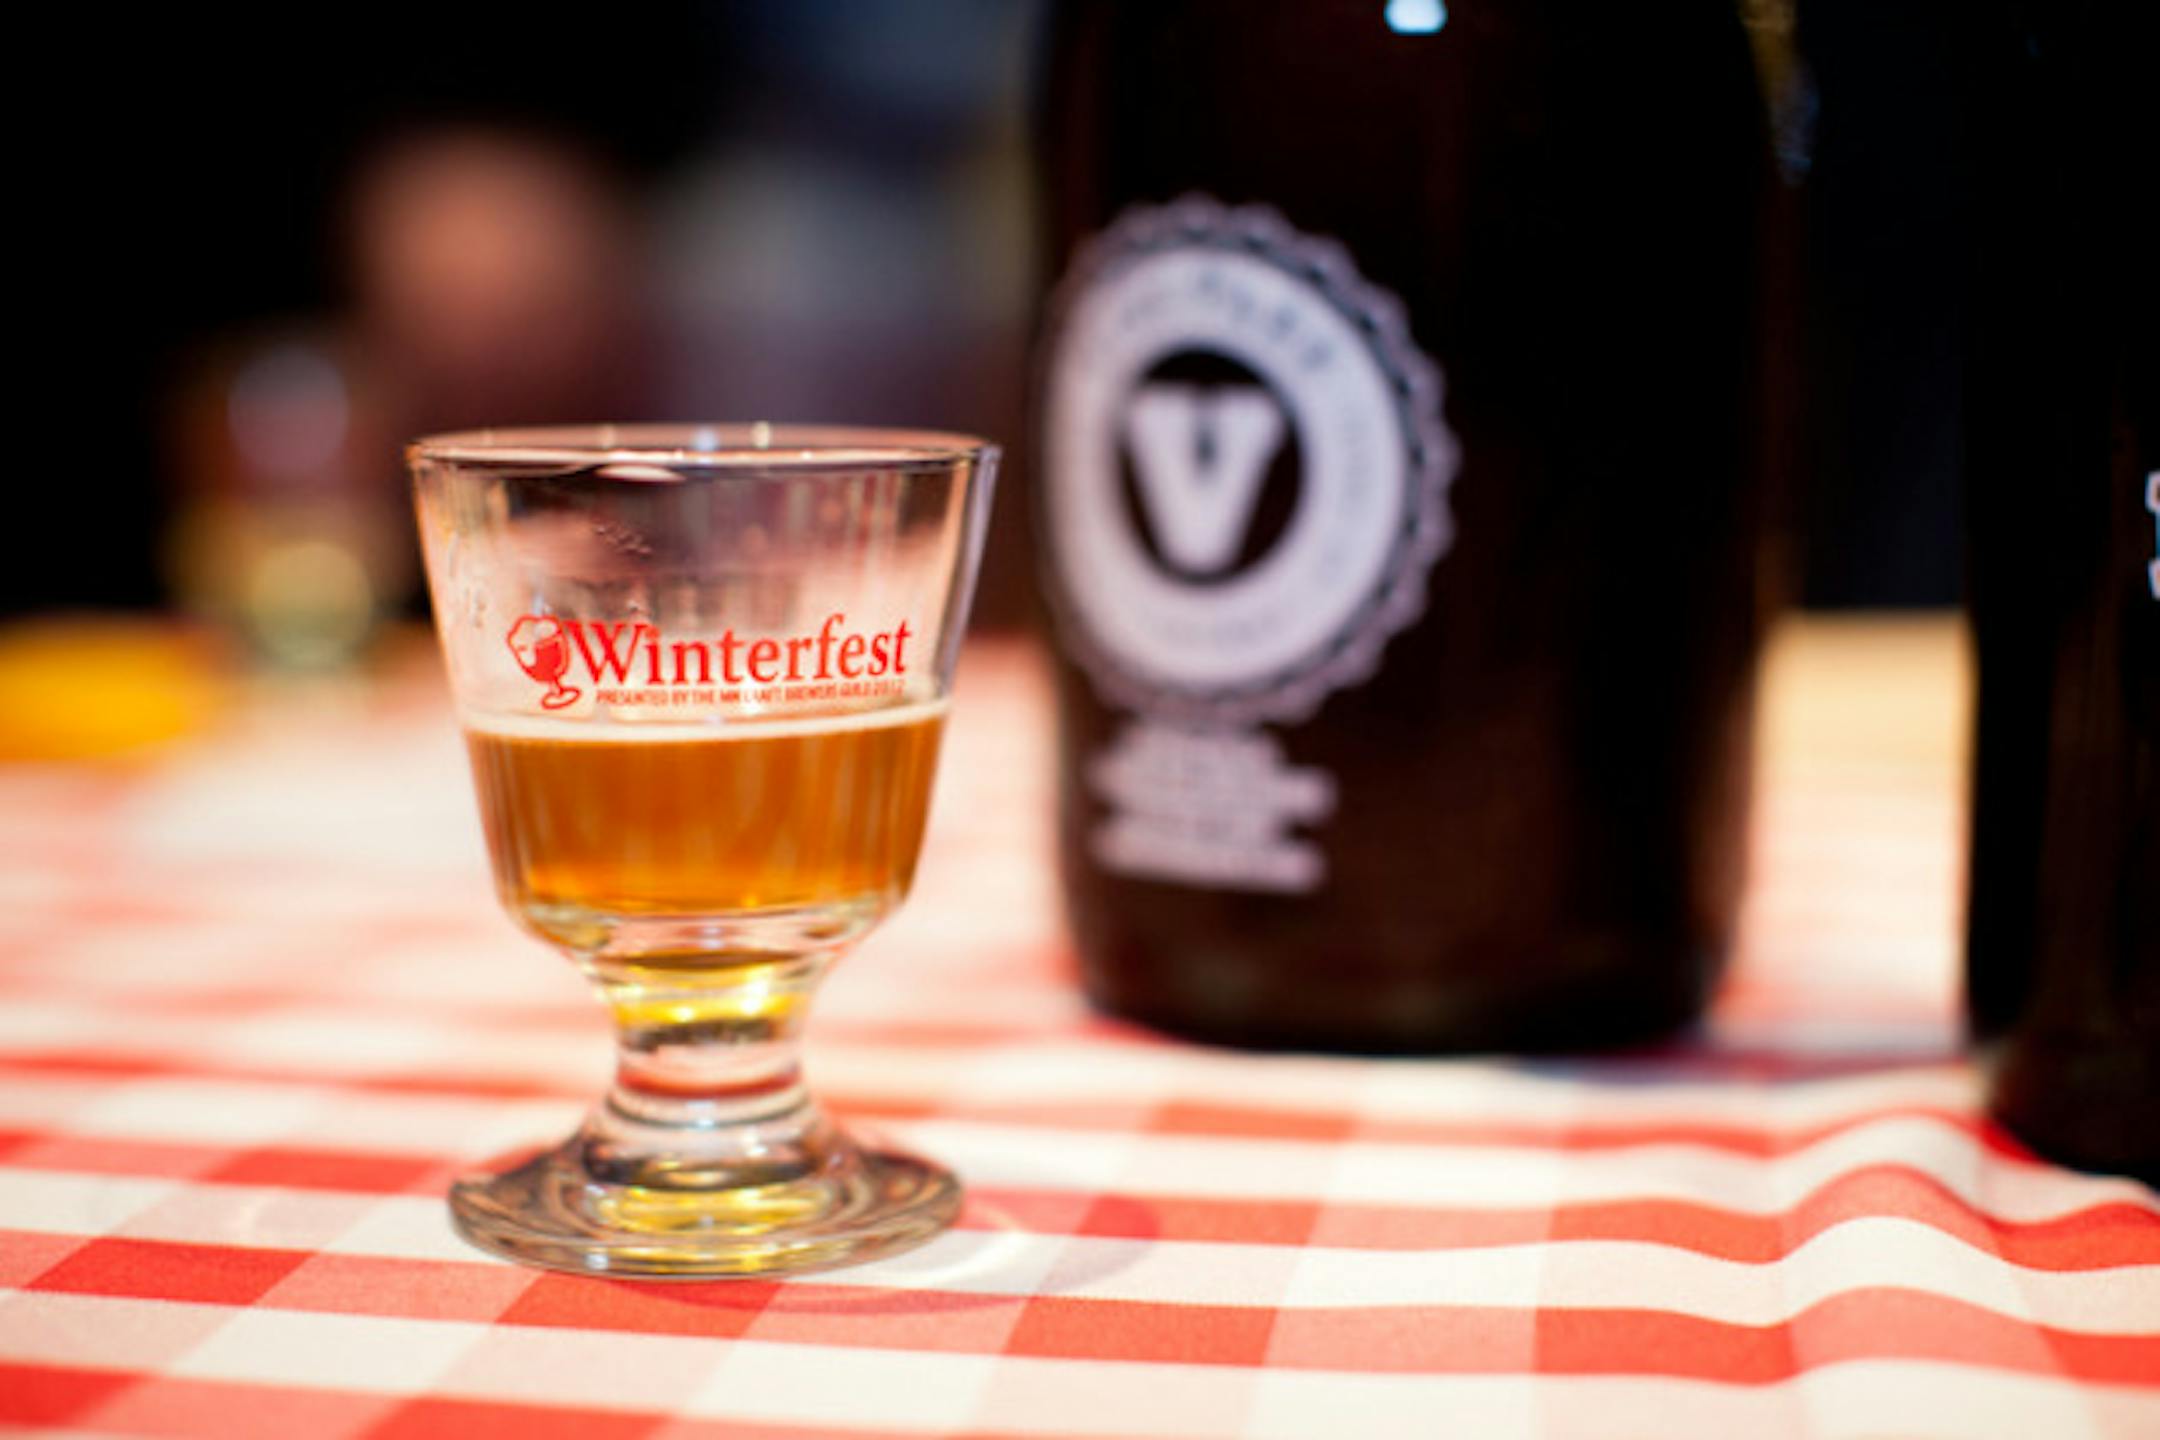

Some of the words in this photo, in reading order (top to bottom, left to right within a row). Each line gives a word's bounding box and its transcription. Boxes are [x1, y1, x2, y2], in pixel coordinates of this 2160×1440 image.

[1126, 387, 1287, 569] V
[564, 613, 911, 686] Winterfest
[595, 689, 668, 706] PRESENTED
[672, 689, 688, 706] BY
[692, 689, 714, 705] THE
